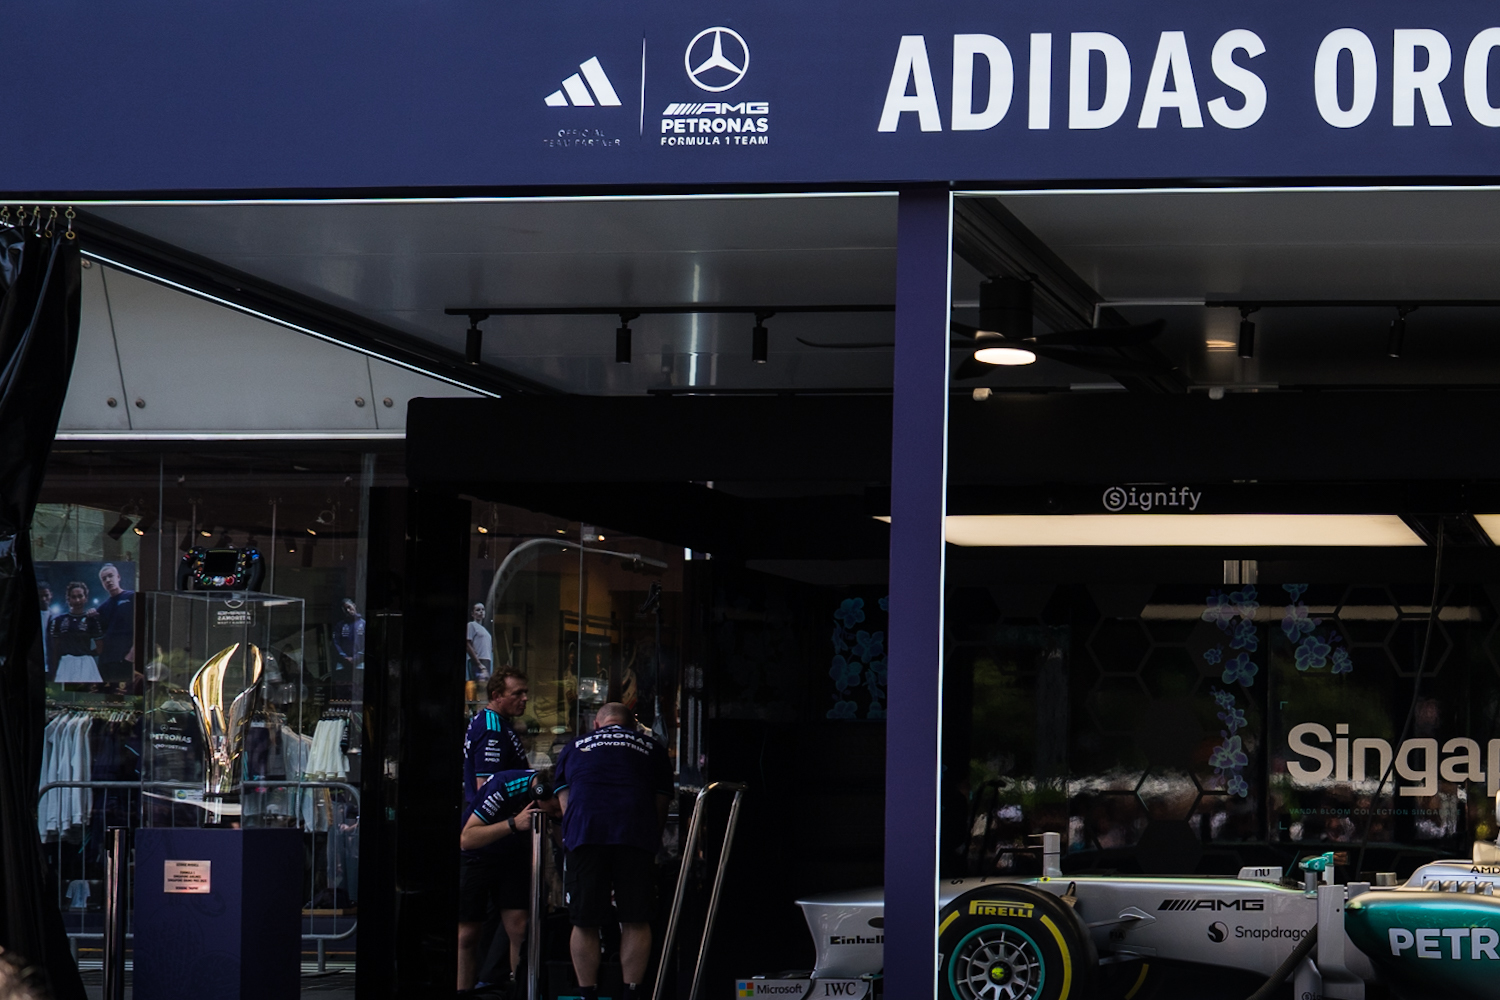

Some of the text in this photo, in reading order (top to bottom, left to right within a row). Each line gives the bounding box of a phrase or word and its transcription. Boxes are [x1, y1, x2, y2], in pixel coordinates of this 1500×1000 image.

[877, 28, 1268, 133] ADIDAS
[690, 102, 769, 115] AMG
[661, 117, 769, 133] PETRONAS
[660, 135, 769, 146] FORMULA 1 TEAM
[575, 733, 653, 750] PETRONAS
[1470, 866, 1500, 875] AMD
[968, 899, 1035, 918] PIRELLI
[1191, 899, 1264, 911] AMG
[757, 984, 803, 995] Microsoft
[825, 982, 856, 997] IWC
